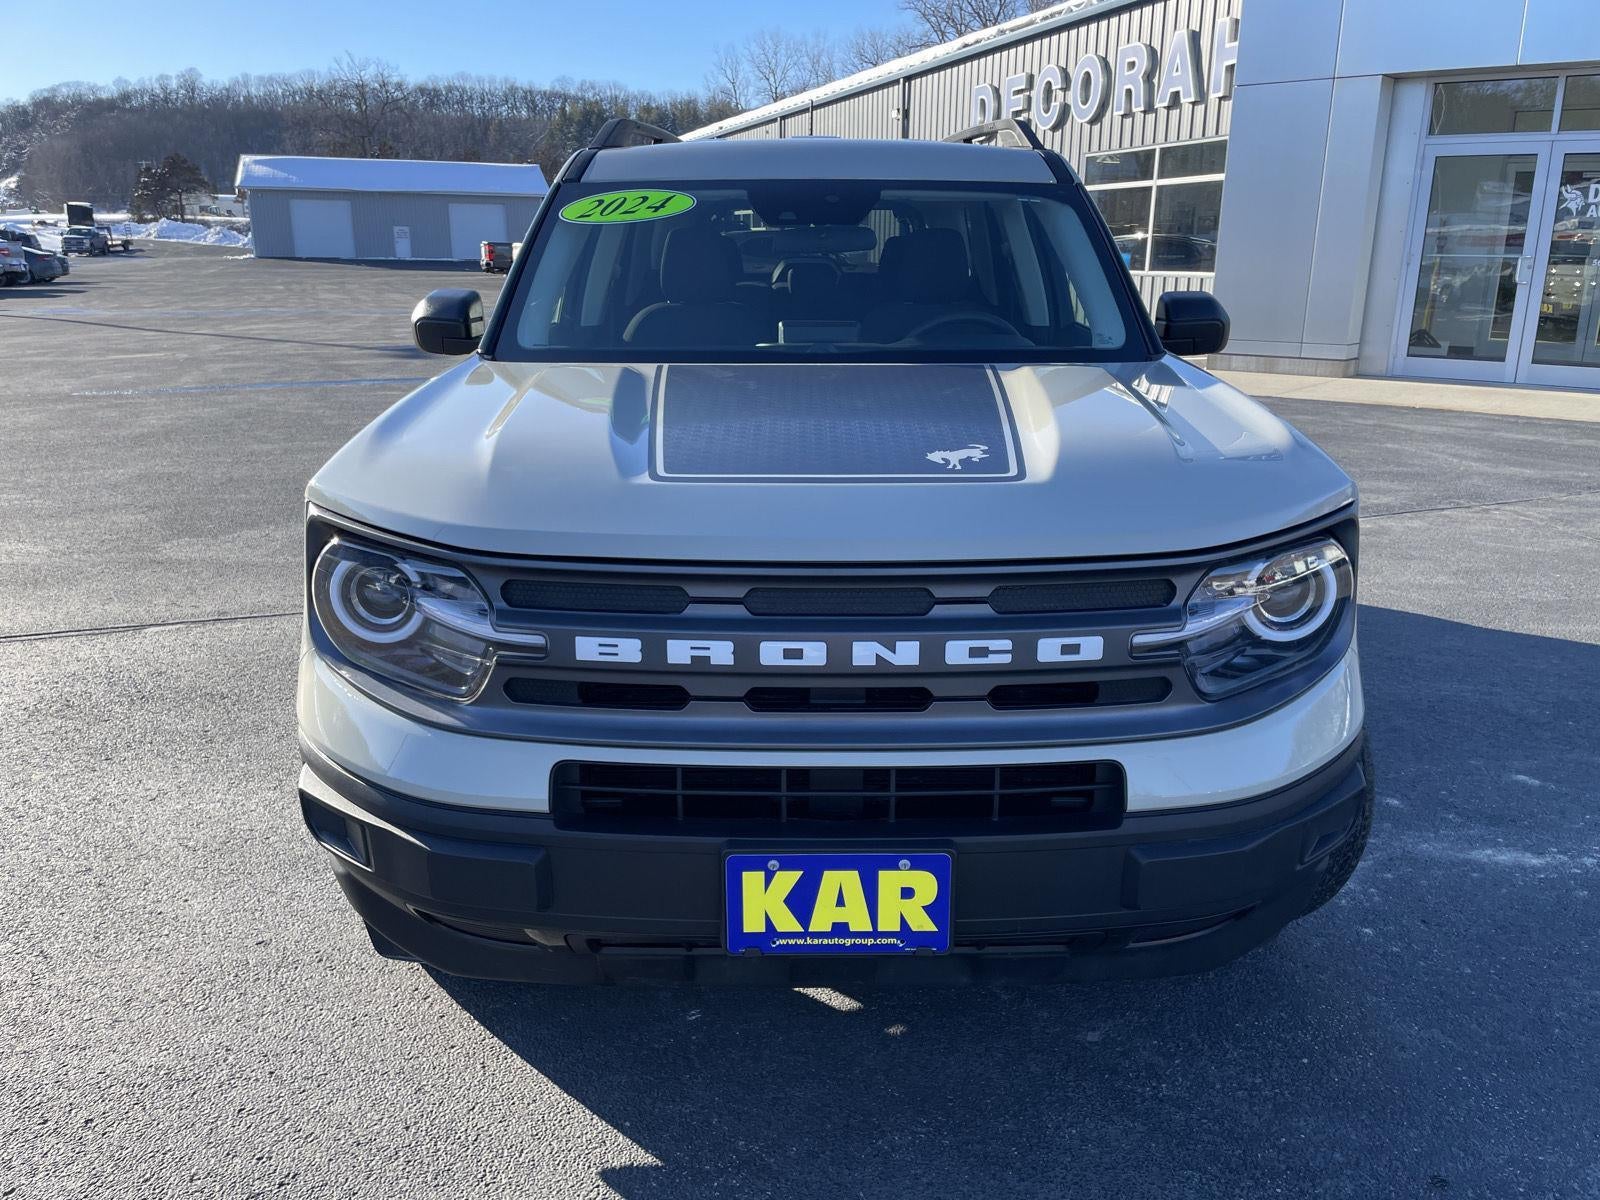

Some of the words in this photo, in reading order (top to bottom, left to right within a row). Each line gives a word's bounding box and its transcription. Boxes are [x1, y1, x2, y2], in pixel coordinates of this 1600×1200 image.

[575, 194, 677, 219] 2024
[575, 635, 1103, 667] BRONCO
[742, 870, 938, 933] KAR
[779, 937, 897, 947] www.karautogroup.com
